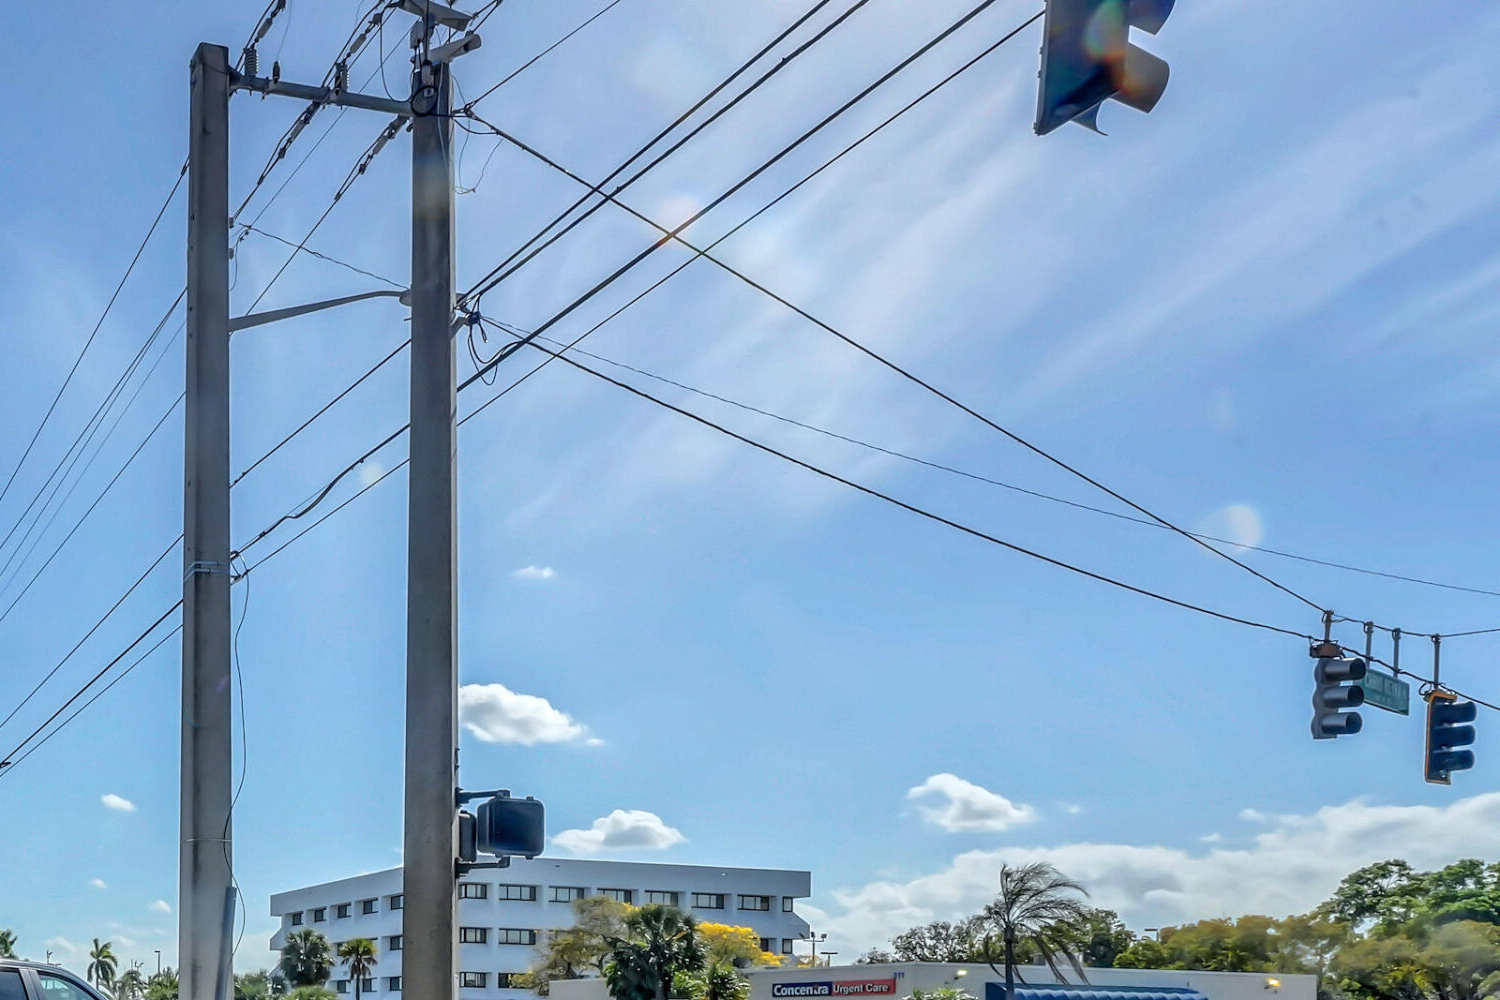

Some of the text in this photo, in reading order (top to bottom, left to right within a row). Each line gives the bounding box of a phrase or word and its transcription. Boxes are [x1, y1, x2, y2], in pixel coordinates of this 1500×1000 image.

[773, 982, 889, 996] Concentra Urgent Care
